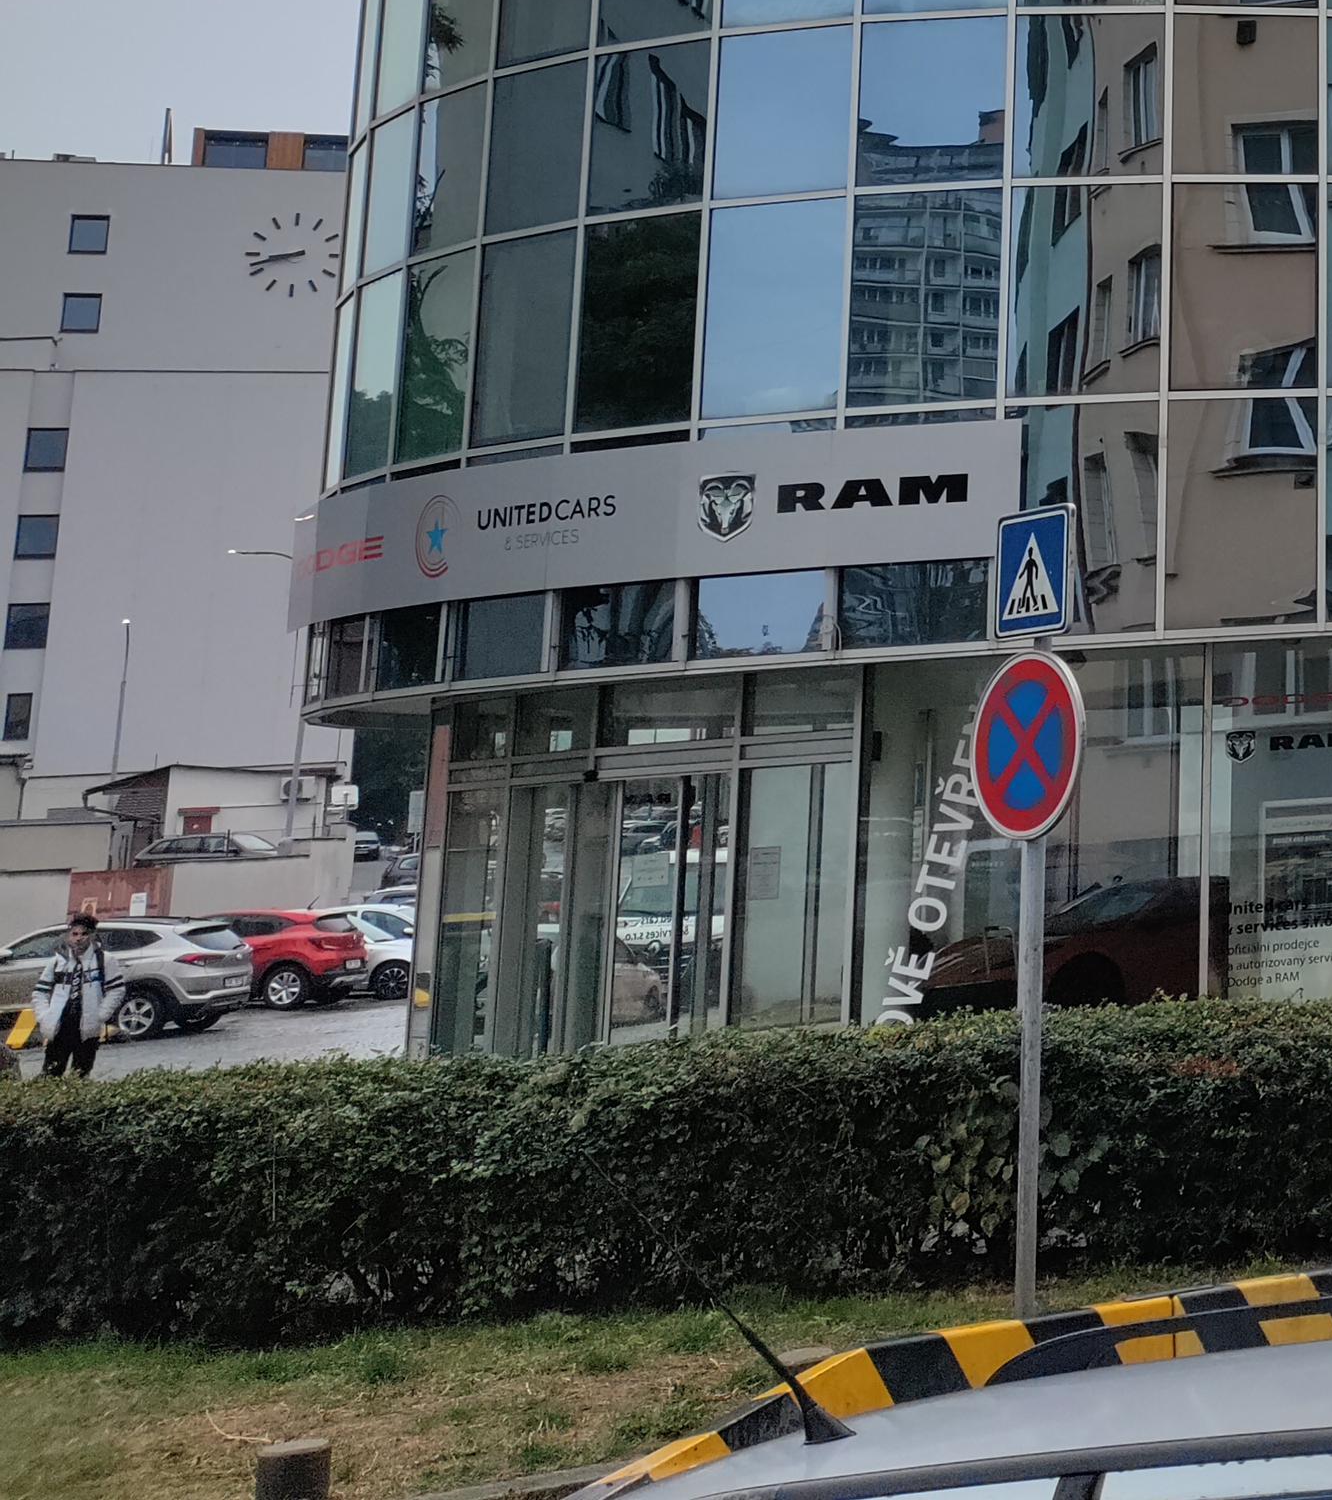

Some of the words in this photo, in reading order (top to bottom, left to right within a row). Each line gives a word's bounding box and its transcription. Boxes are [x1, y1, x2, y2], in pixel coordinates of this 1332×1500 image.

[776, 473, 969, 514] RAM
[516, 528, 580, 551] SERVICES
[1272, 938, 1320, 954] prodejce
[1227, 975, 1264, 990] Dodge
[1265, 974, 1273, 984] a
[1275, 971, 1300, 983] RAM
